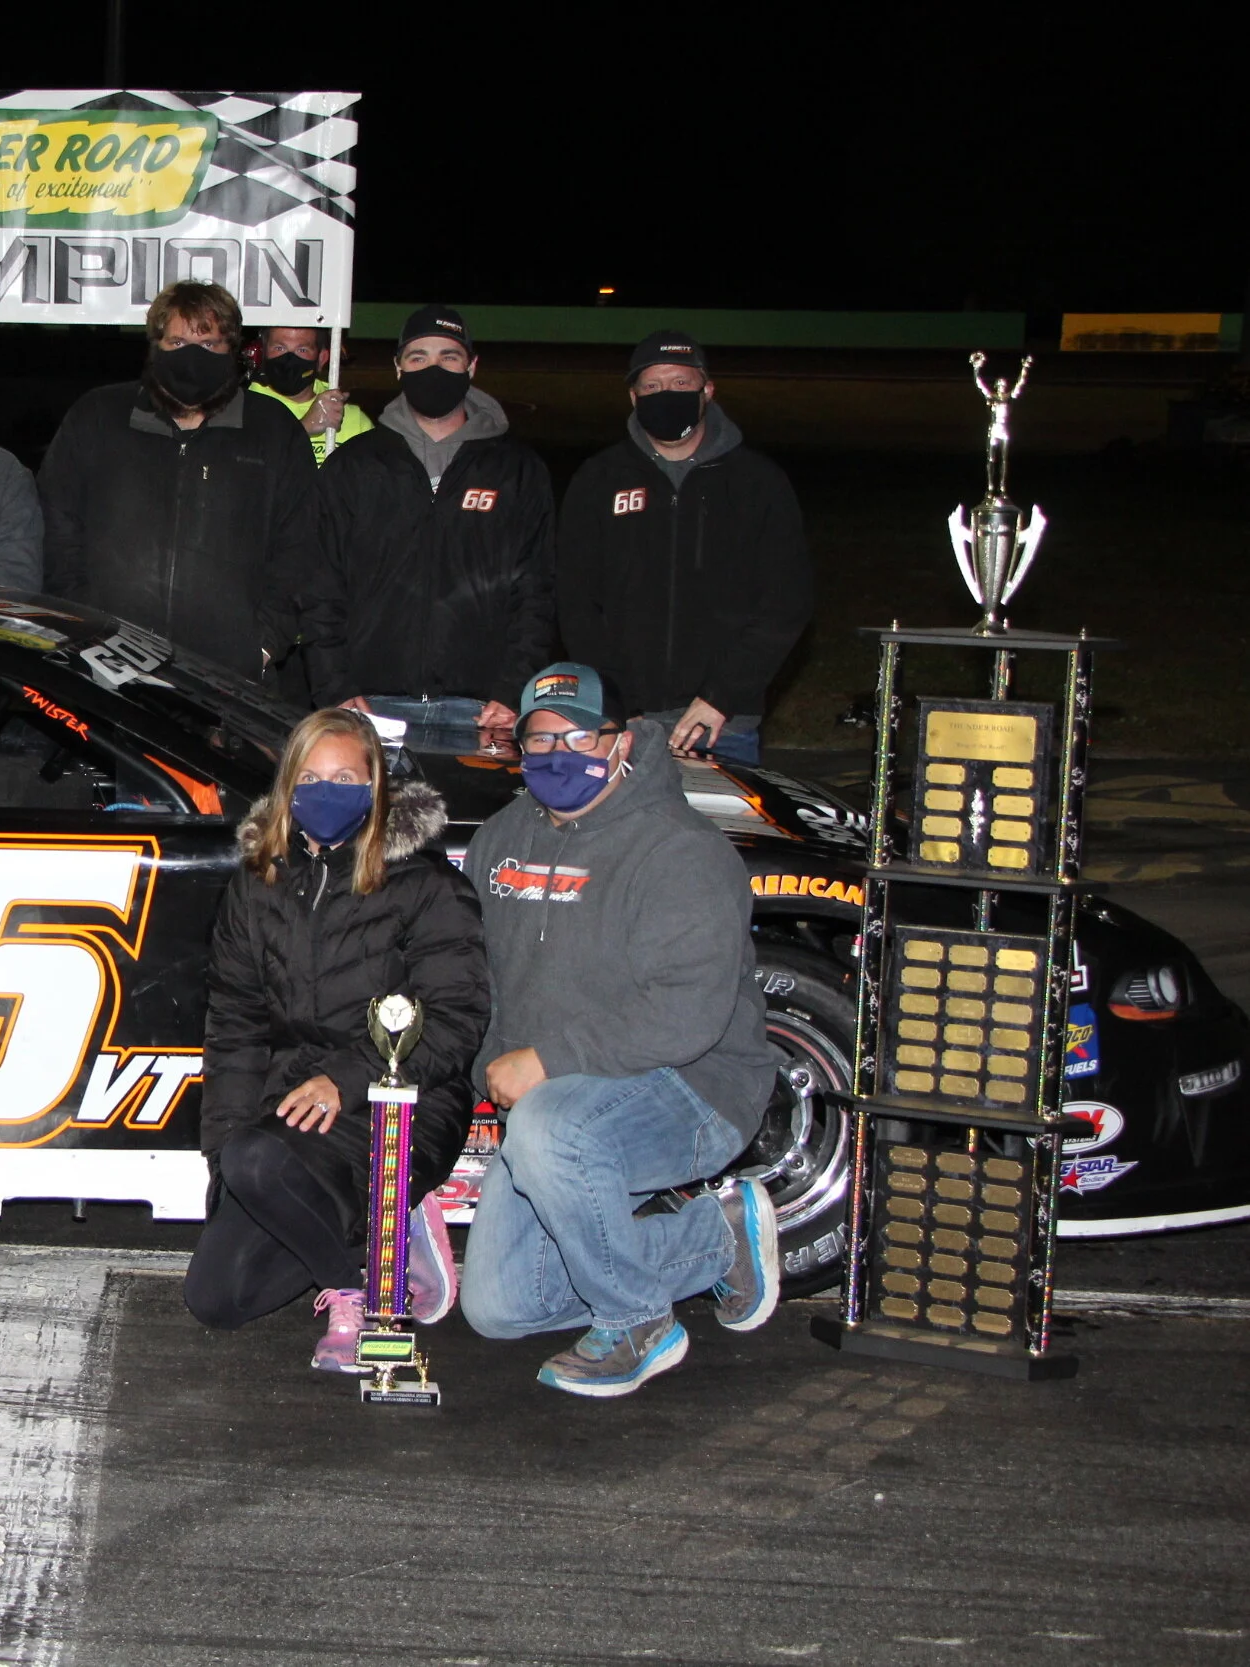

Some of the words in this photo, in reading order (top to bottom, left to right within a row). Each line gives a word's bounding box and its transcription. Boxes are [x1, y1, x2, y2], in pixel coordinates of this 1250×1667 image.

[53, 133, 181, 175] ROAD
[7, 176, 31, 202] of
[462, 489, 498, 512] 66
[613, 488, 645, 515] 66
[23, 686, 88, 741] TWISTER
[75, 1052, 203, 1125] VT
[1077, 1158, 1114, 1174] STAR
